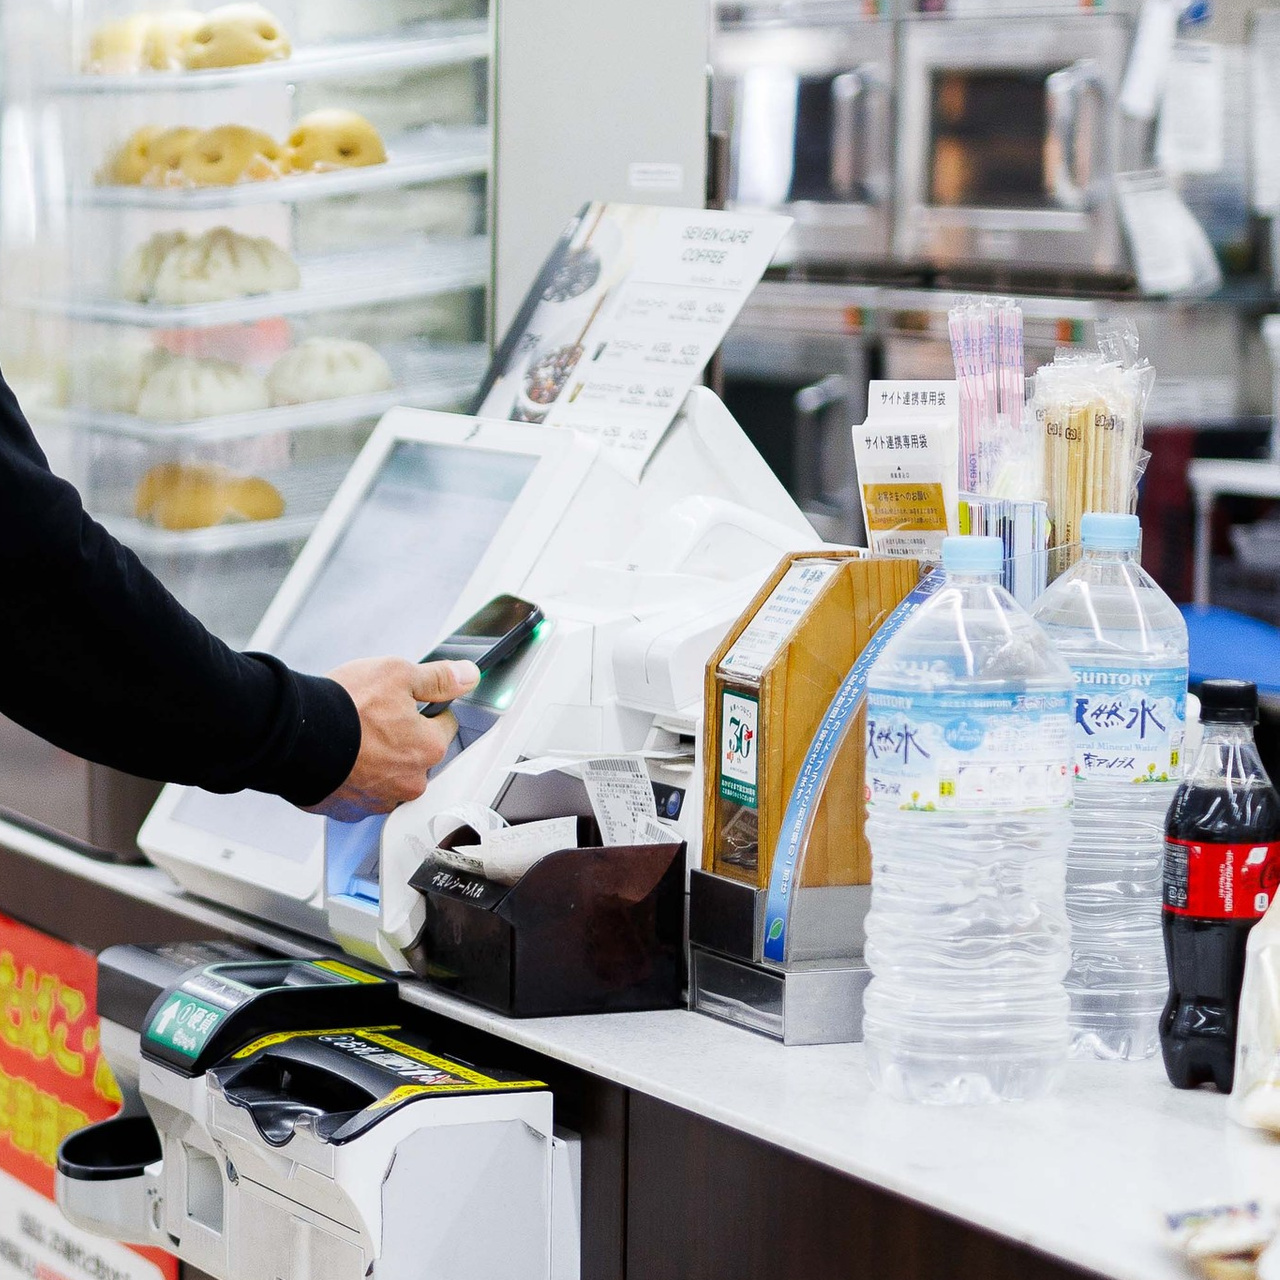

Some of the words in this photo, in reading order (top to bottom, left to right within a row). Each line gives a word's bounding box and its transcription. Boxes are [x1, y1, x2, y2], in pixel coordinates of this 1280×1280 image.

[881, 391, 946, 407] サイト連携専用袋
[865, 434, 928, 450] サイト連携専用袋
[1072, 671, 1153, 686] SUNTORY
[1082, 752, 1136, 770] 南アルプス
[432, 871, 485, 899] 不要レシート入れ
